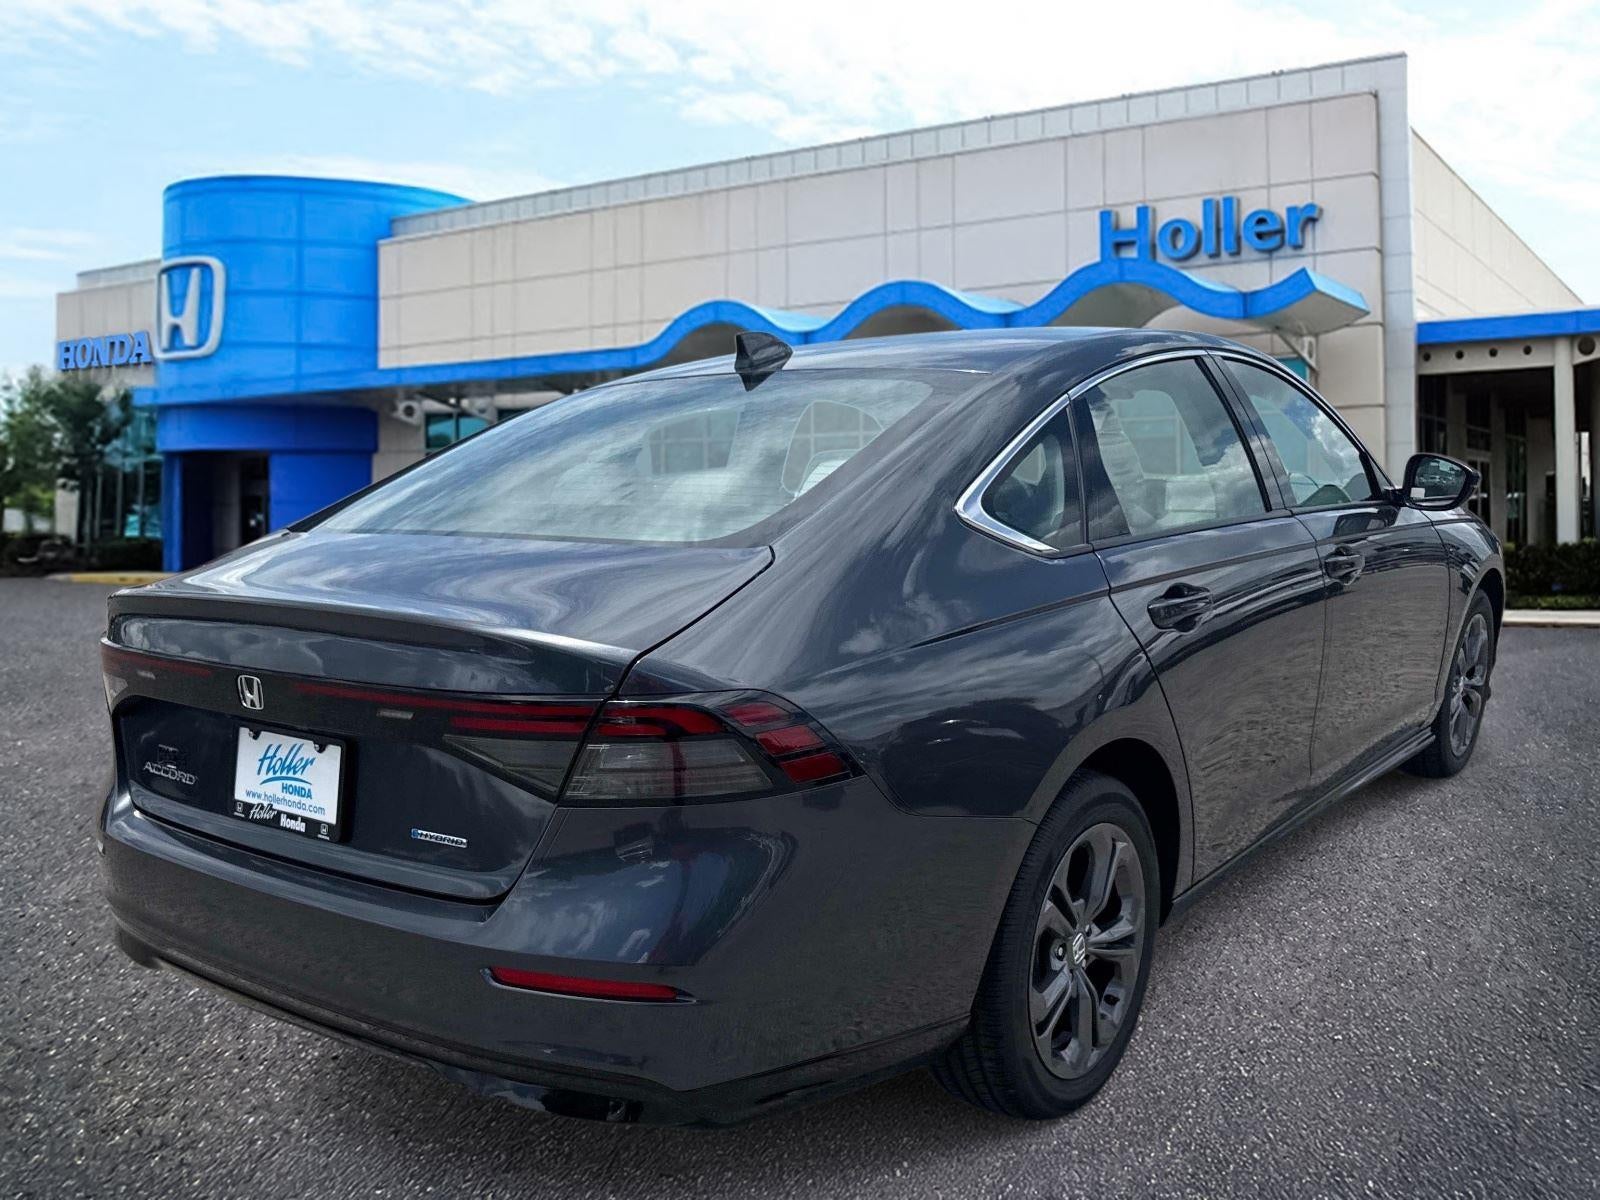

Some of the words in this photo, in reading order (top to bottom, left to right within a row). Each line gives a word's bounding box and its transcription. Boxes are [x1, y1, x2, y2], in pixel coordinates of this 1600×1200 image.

[1099, 196, 1323, 262] Holler
[57, 331, 152, 371] HONDA
[143, 761, 197, 785] ACCORD
[257, 743, 316, 776] Holler
[245, 788, 326, 816] www.hollerhonda.com
[281, 782, 313, 800] HONDA
[249, 803, 278, 820] Holler
[280, 813, 306, 833] Honda
[418, 830, 466, 847] HYBRID
